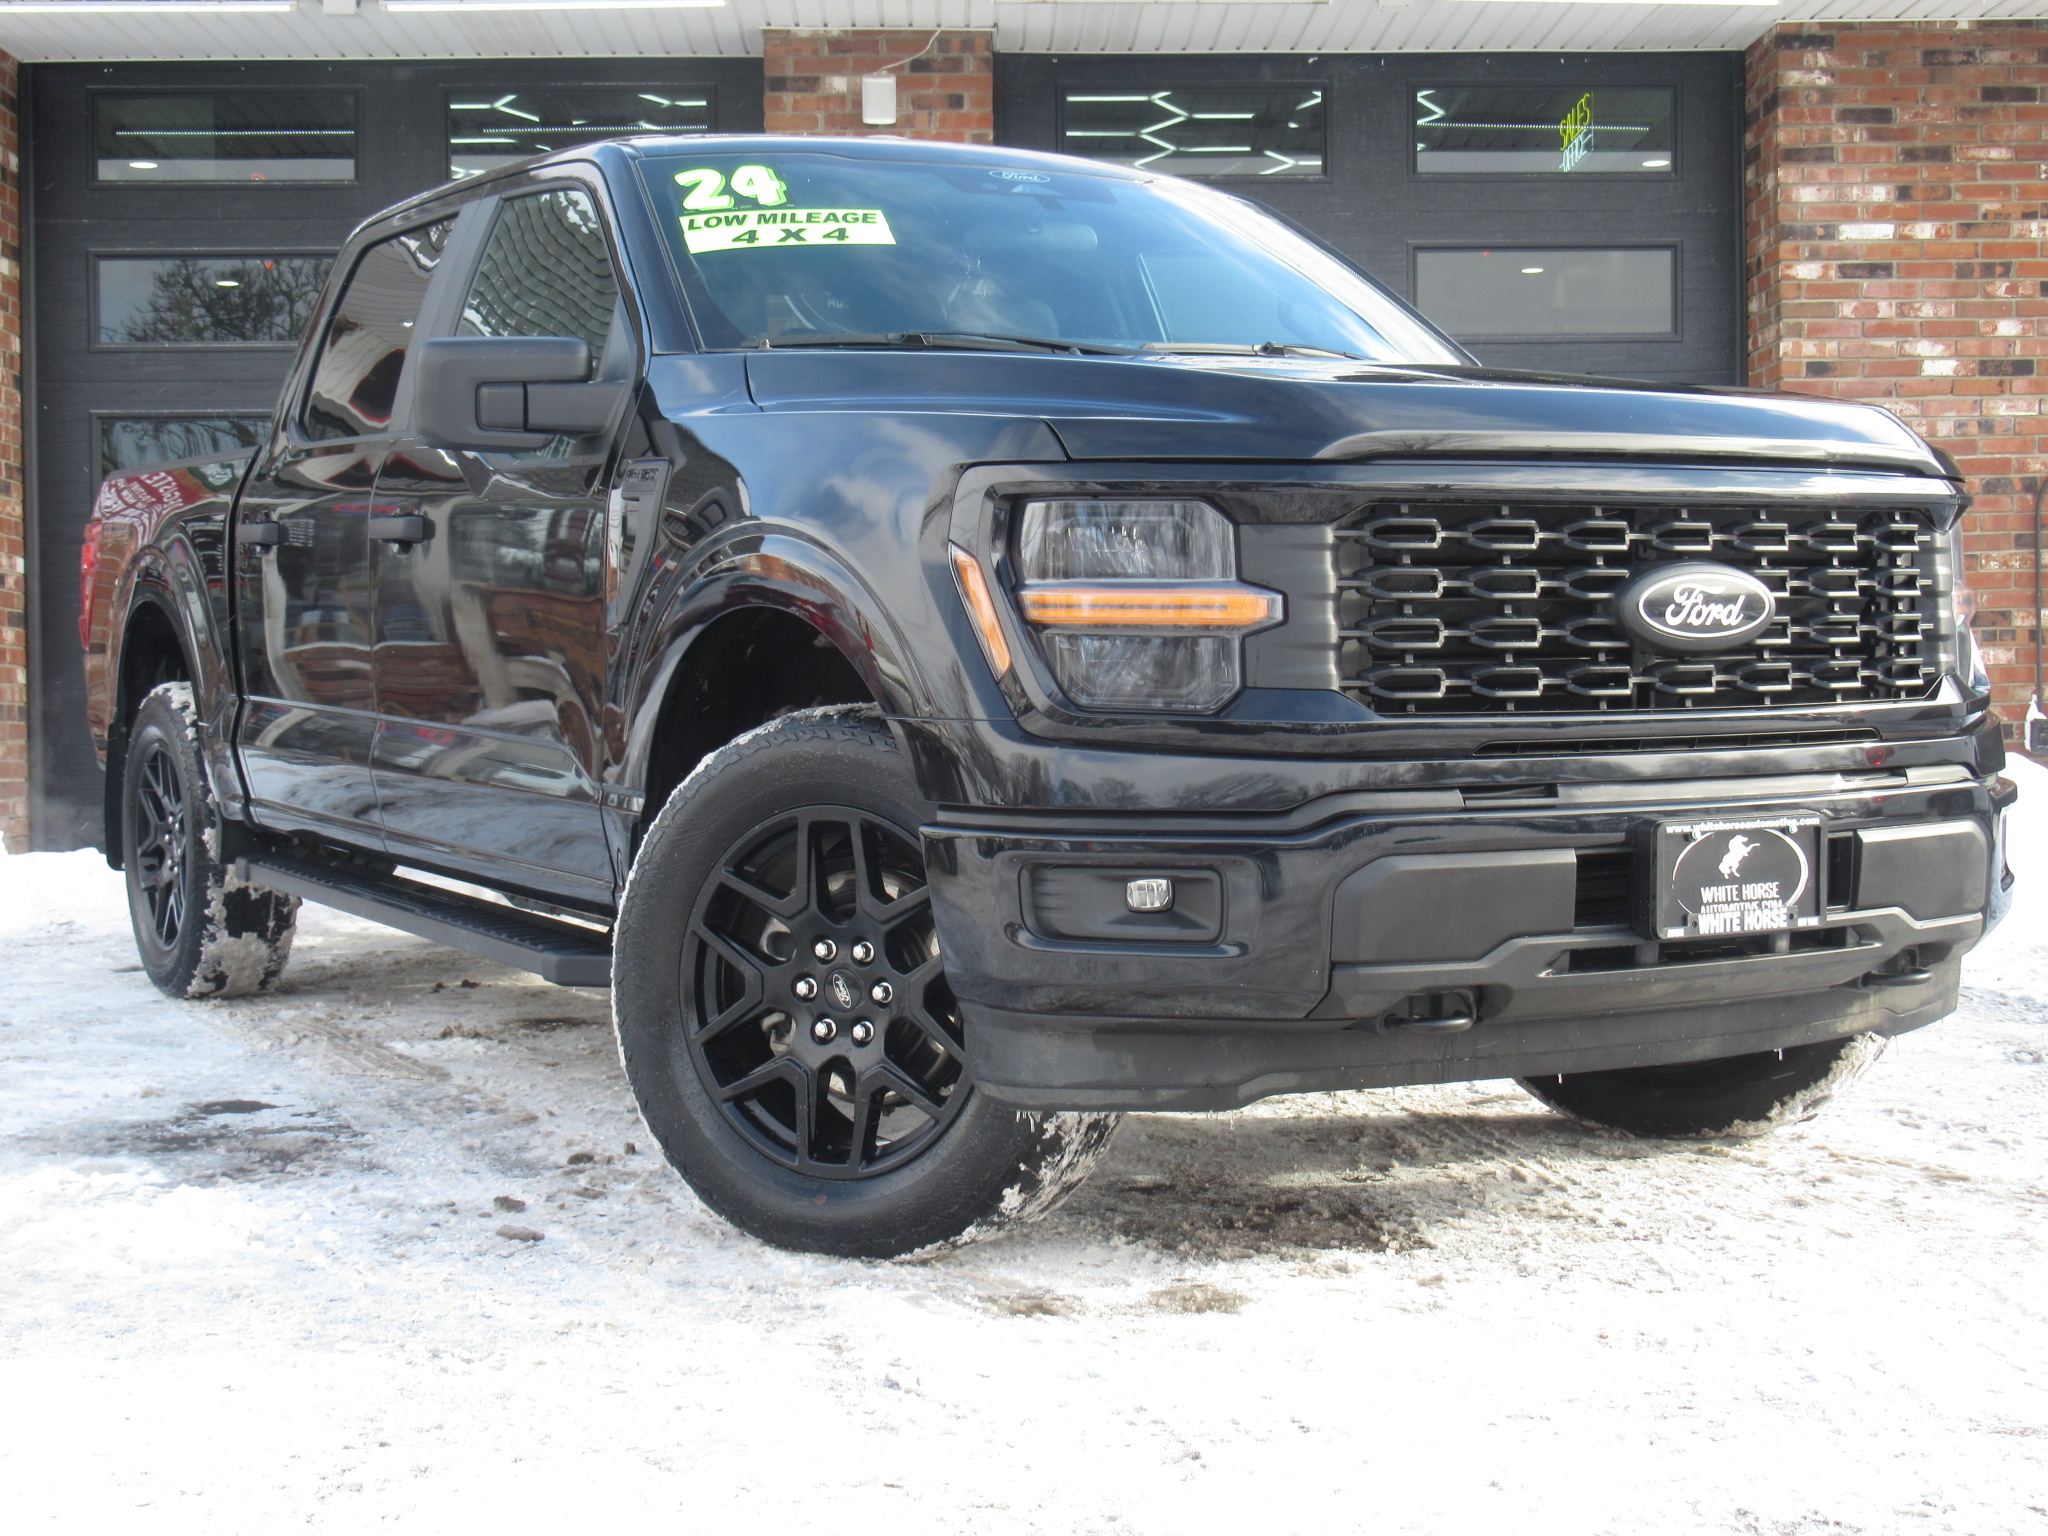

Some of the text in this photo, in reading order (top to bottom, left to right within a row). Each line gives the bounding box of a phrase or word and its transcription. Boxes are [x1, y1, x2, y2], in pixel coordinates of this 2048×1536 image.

[1559, 92, 1591, 152] SALES
[673, 164, 788, 211] 24
[687, 212, 878, 231] LOW MILEAGE
[1664, 583, 1746, 627] Ford
[1665, 817, 1820, 834] www.whitehorseautomotive.com
[1700, 881, 1780, 904] WHITE HORSE
[1698, 911, 1740, 935] WHITE
[1743, 907, 1788, 931] HORSE
